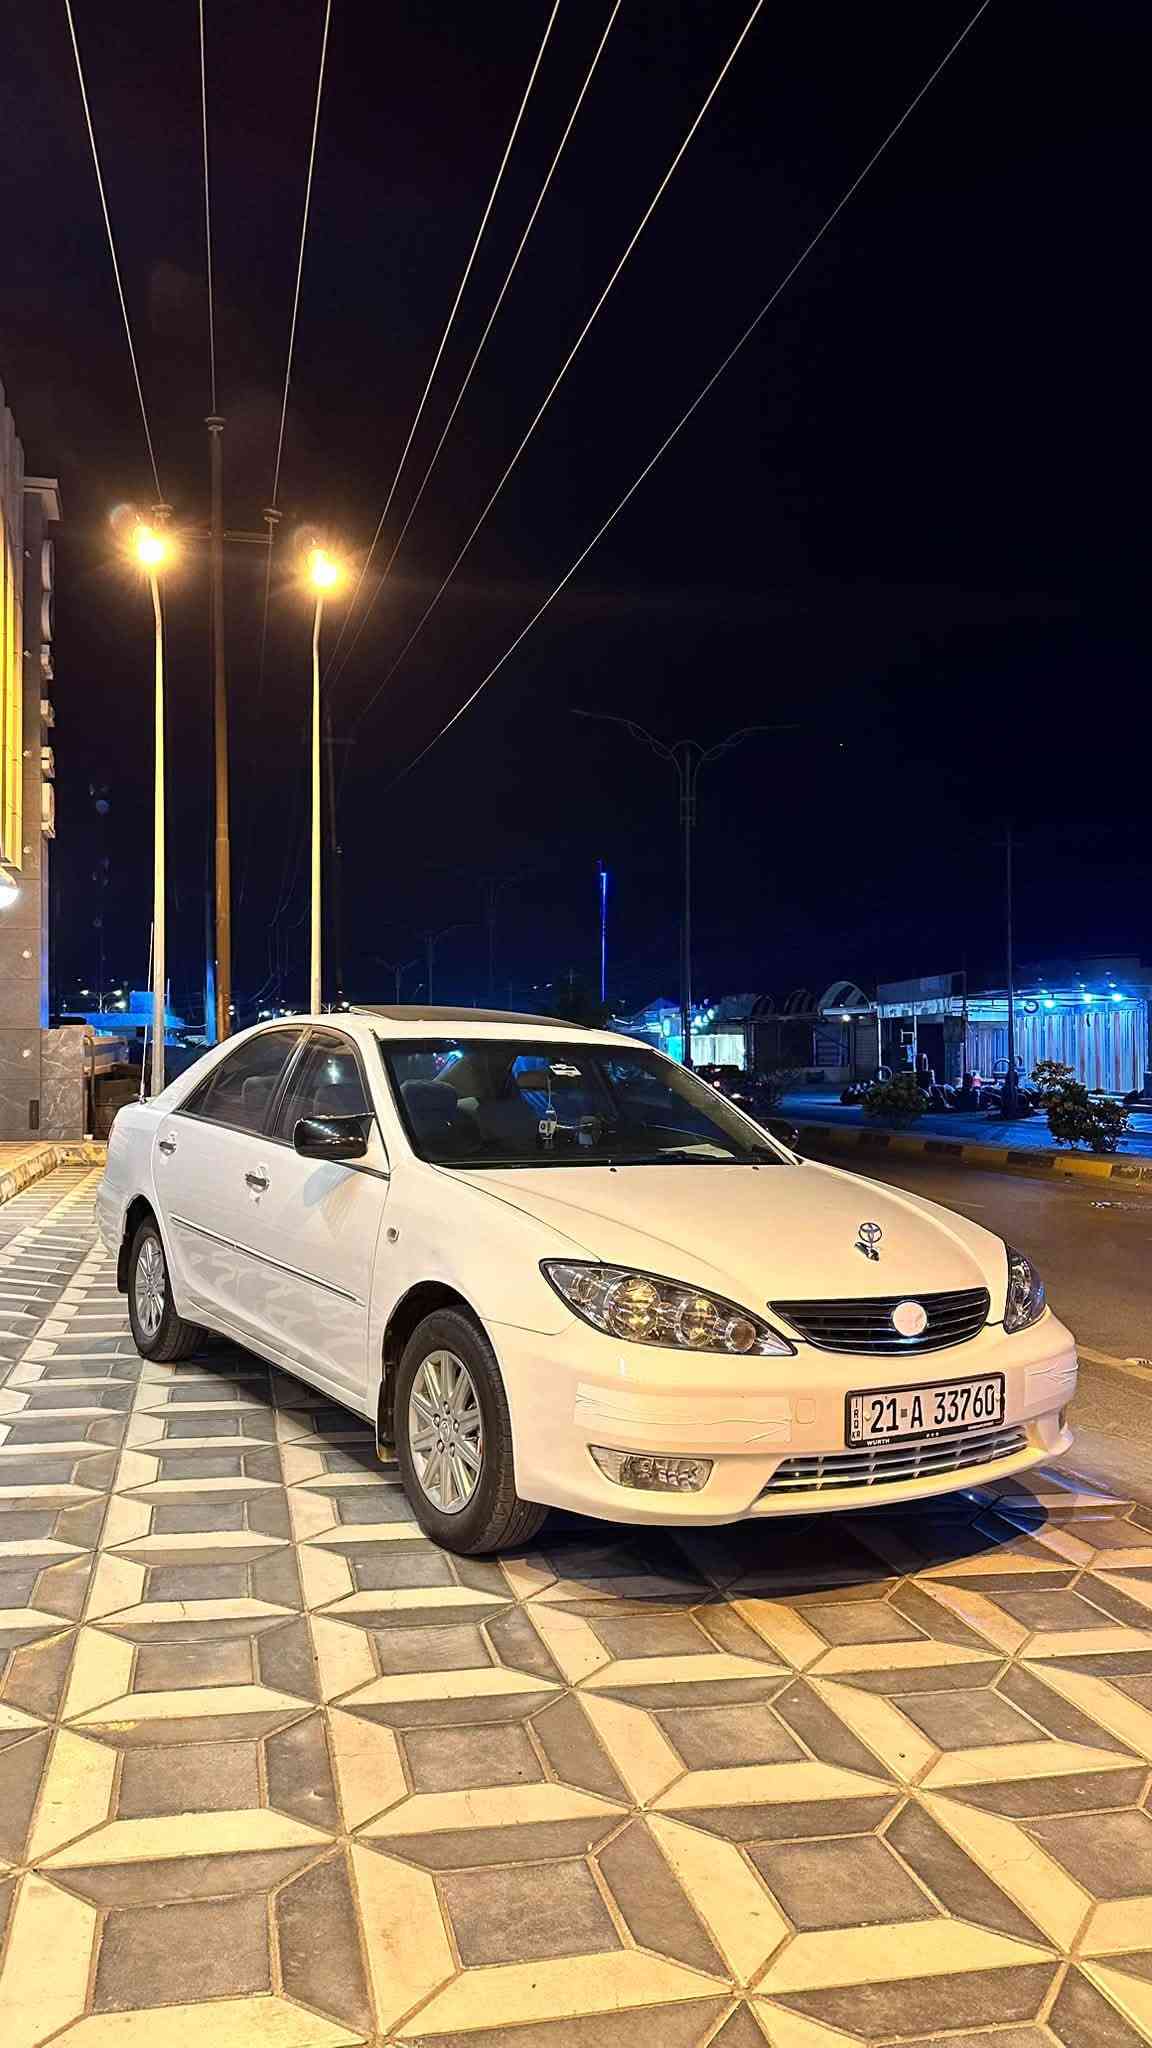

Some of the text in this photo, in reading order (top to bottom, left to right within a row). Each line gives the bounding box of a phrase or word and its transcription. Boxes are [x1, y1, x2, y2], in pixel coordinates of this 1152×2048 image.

[871, 1384, 995, 1433] 21 A 33760
